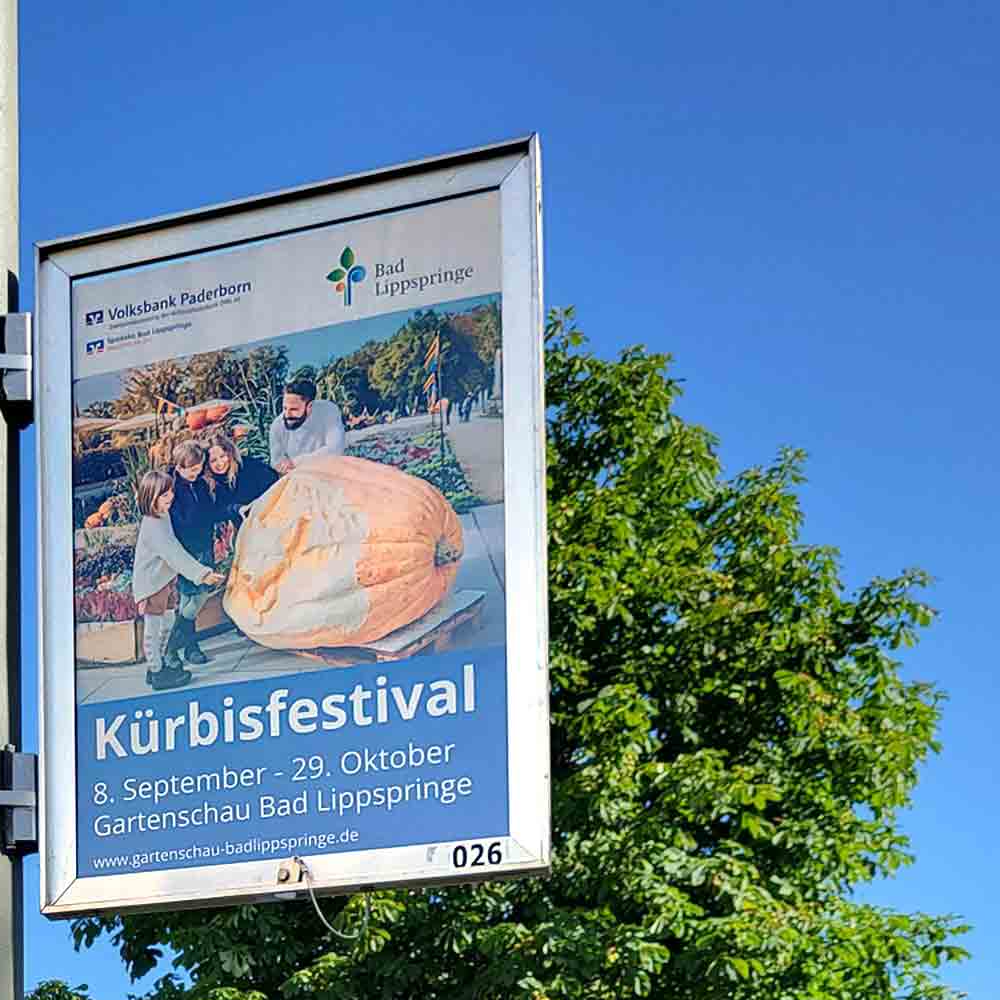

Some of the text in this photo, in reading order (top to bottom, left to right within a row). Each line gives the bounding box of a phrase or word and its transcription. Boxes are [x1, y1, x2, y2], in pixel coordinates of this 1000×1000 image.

[375, 258, 405, 278] Bad
[375, 265, 474, 297] Lippspringe
[108, 295, 177, 321] Volksbank
[180, 281, 252, 306] Paderborn
[95, 664, 476, 760] Kürbisfestival
[93, 782, 115, 805] 8.
[123, 766, 267, 804] September
[291, 755, 331, 781] 29.
[340, 742, 456, 775] Oktober
[94, 775, 473, 837] Gartenschau Bad Lippspringe
[93, 828, 360, 869] www.gartenschau-badlippspringe.de
[452, 842, 503, 869] 026
